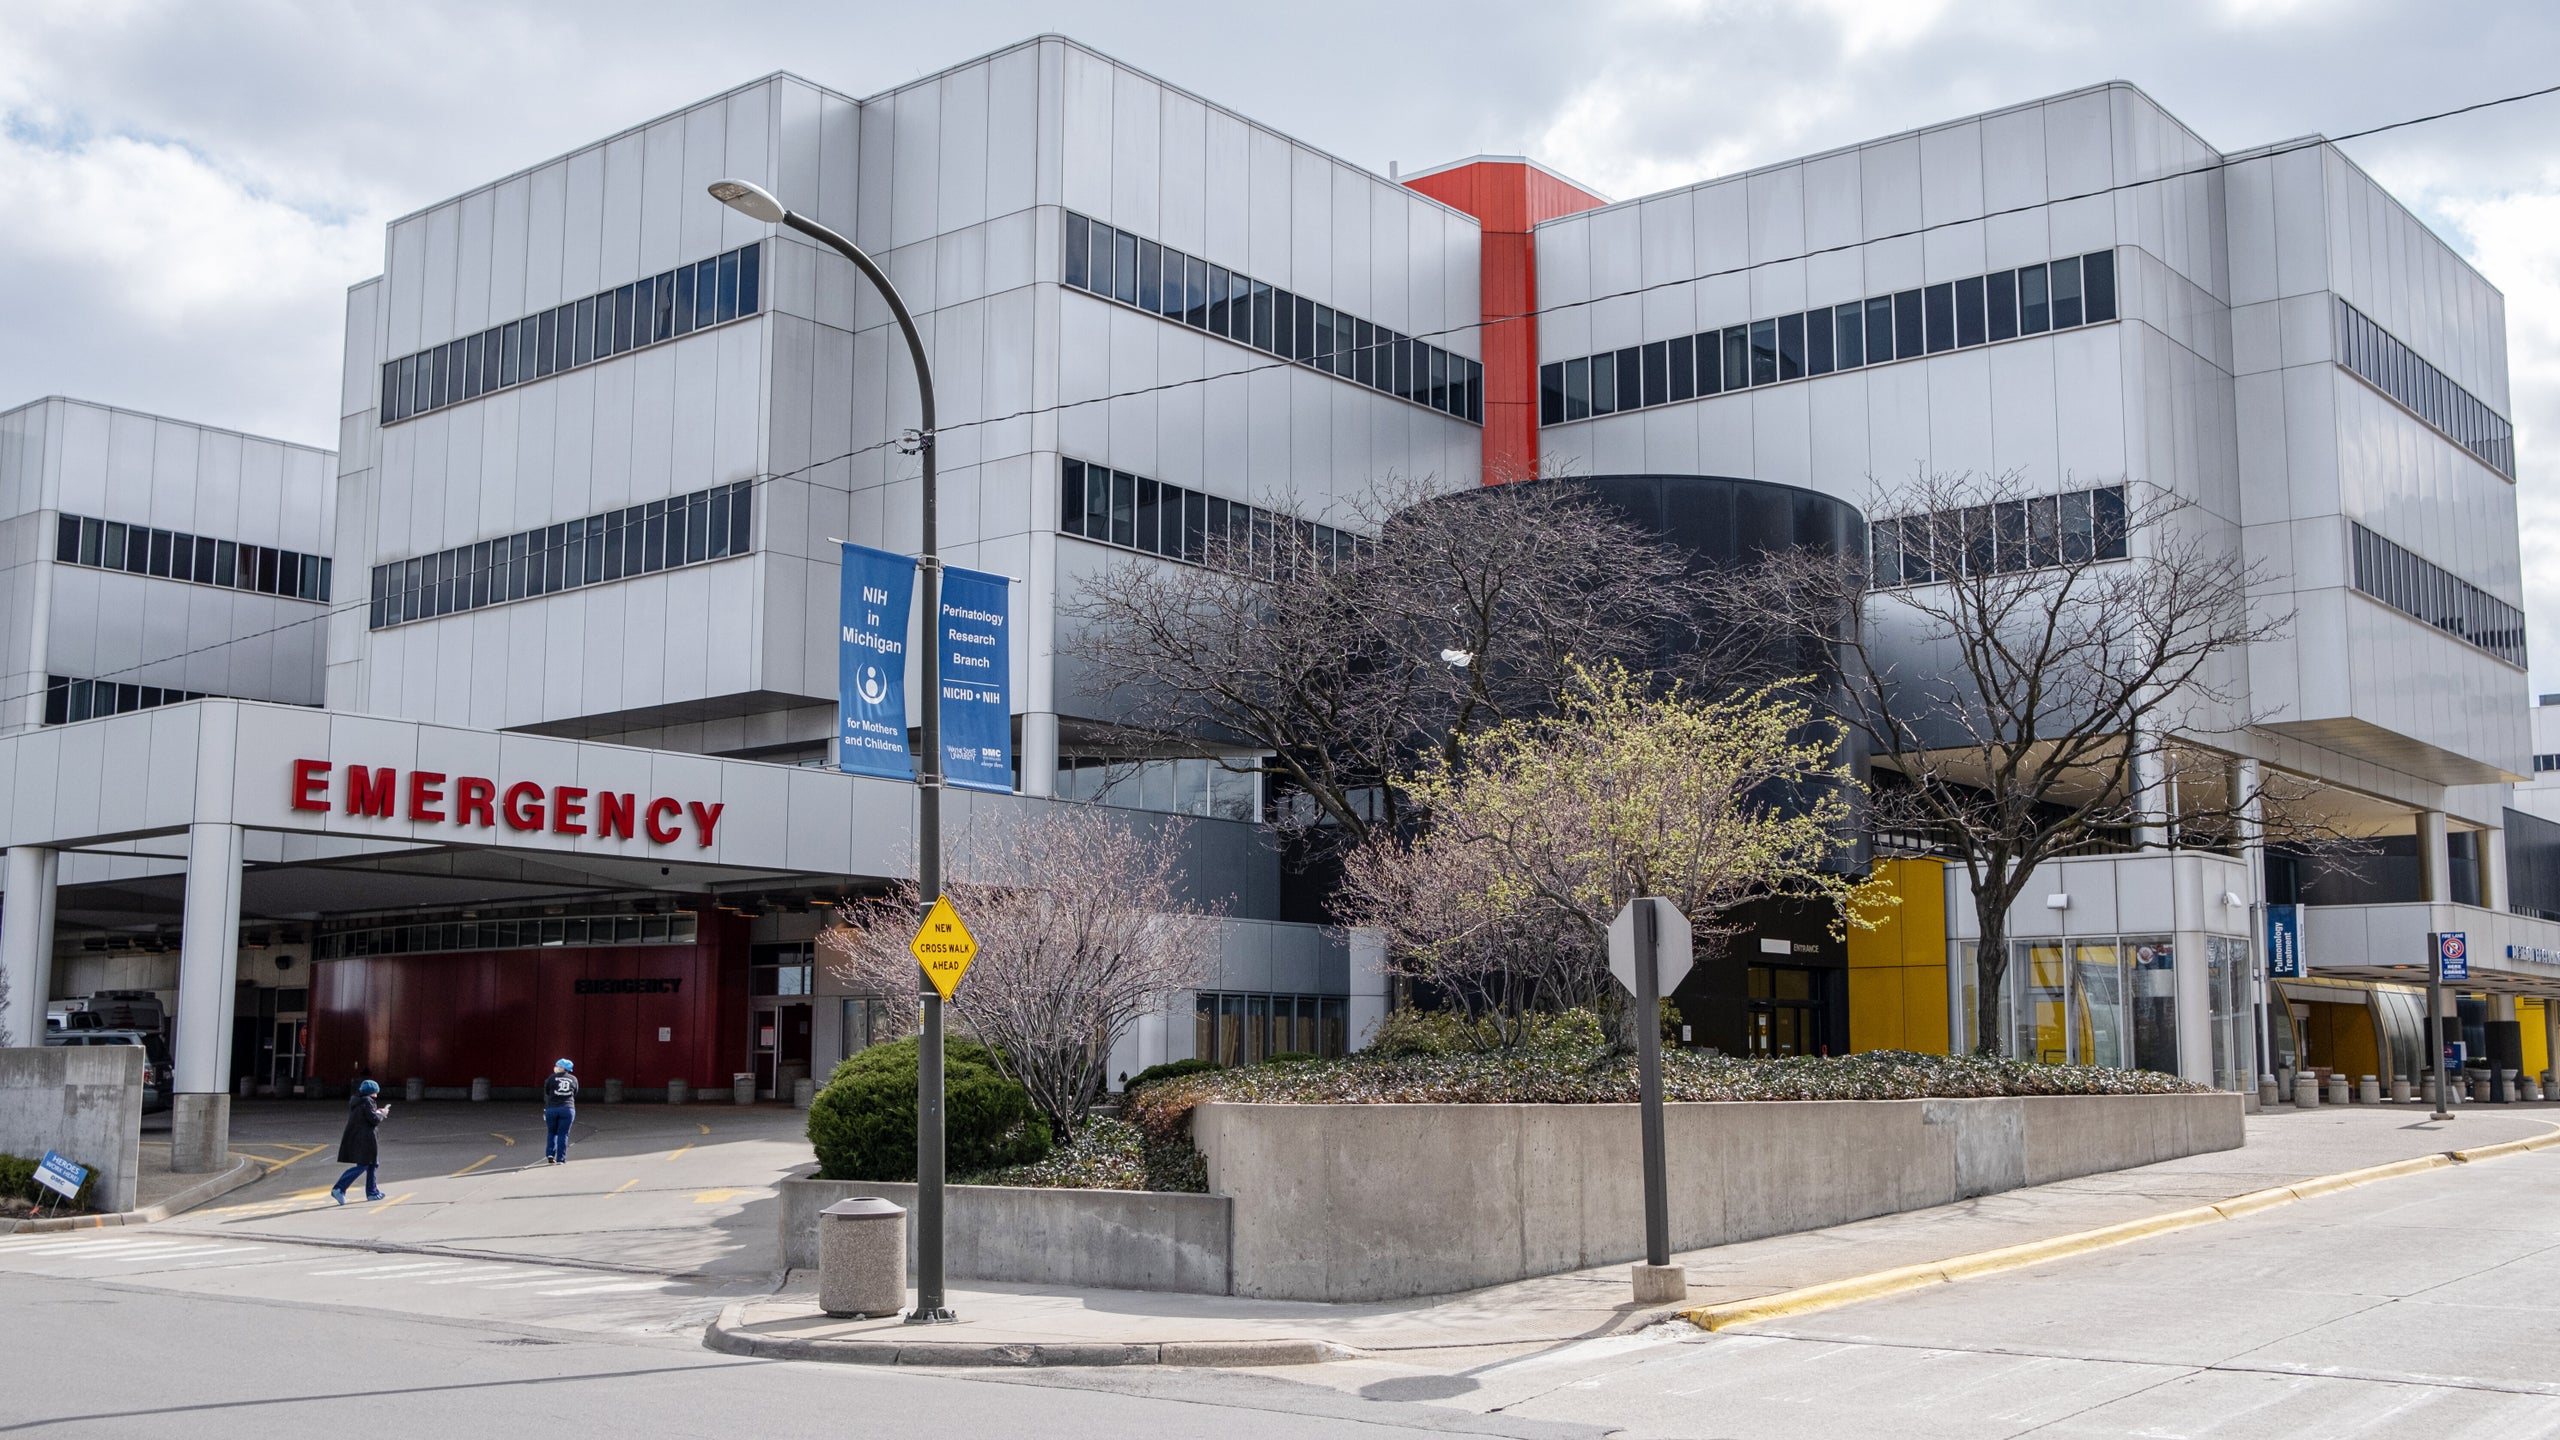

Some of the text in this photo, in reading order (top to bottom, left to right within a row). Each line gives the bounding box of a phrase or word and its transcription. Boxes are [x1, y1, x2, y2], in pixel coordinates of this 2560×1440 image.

[863, 585, 888, 606] NIH
[867, 609, 880, 627] in
[942, 603, 1004, 627] Perinatology
[842, 625, 902, 655] Michigan
[948, 628, 996, 646] Research
[953, 652, 990, 669] Branch
[943, 686, 1000, 705] NICHD NIH
[847, 717, 898, 736] for Mothers
[844, 735, 903, 753] and Children
[981, 747, 1002, 758] DMC
[291, 758, 725, 848] EMERGENCY
[935, 923, 952, 932] NEW
[920, 943, 970, 954] CROSS WALK
[1793, 943, 1819, 953] ENTRANCE
[2273, 921, 2284, 973] Pulmonology
[2284, 931, 2294, 972] Treatment
[932, 961, 959, 970] AHEAD
[574, 977, 683, 994] EMERGENCY
[45, 1160, 63, 1174] WORK
[52, 1155, 80, 1175] HEROES
